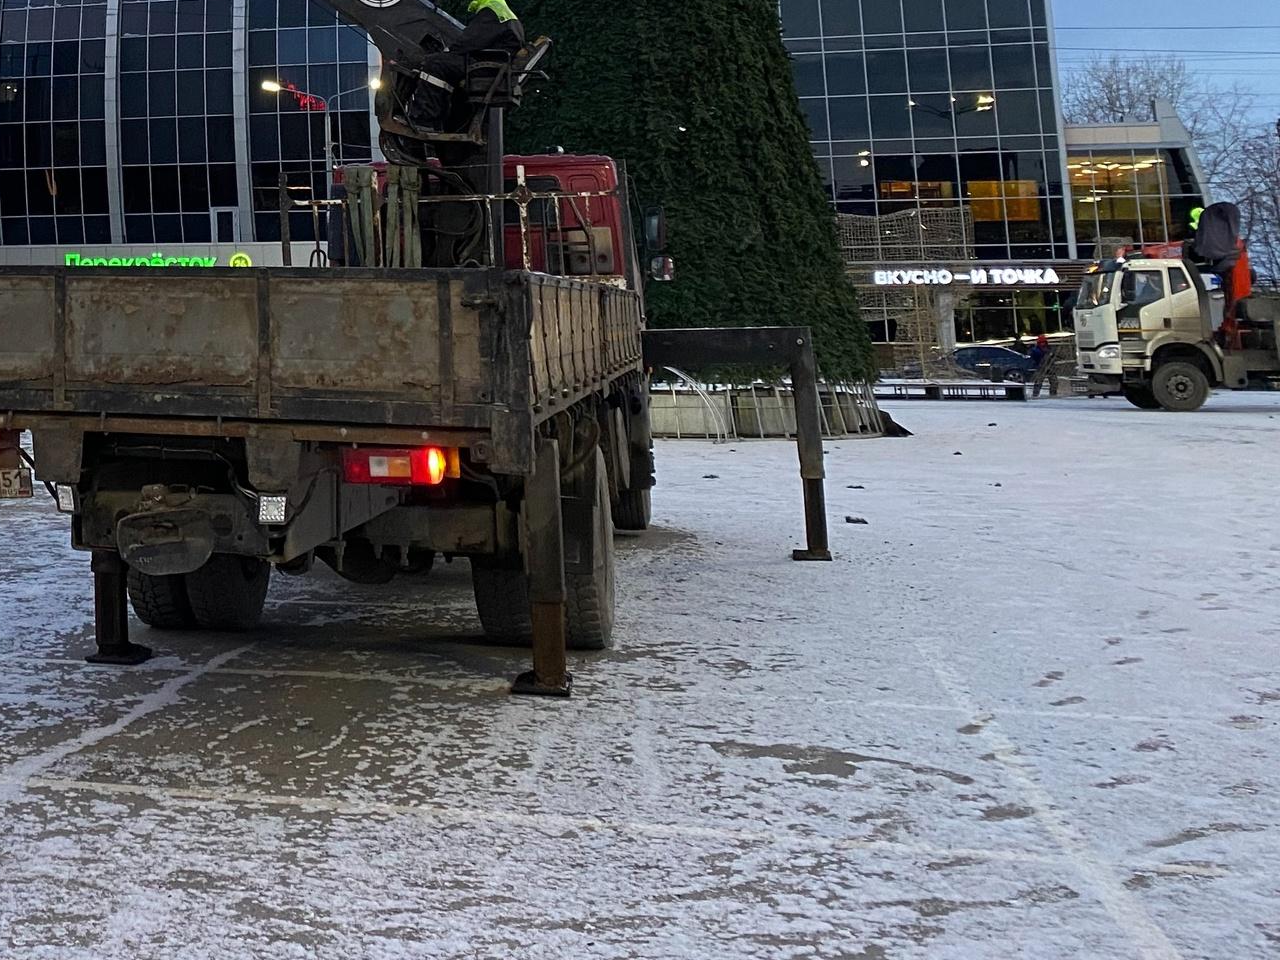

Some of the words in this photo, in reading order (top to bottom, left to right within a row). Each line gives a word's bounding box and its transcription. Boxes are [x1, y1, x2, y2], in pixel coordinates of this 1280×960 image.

[873, 269, 953, 285] ВКУСНО
[989, 268, 1060, 284] ТОЧКА
[2, 471, 23, 488] 51
